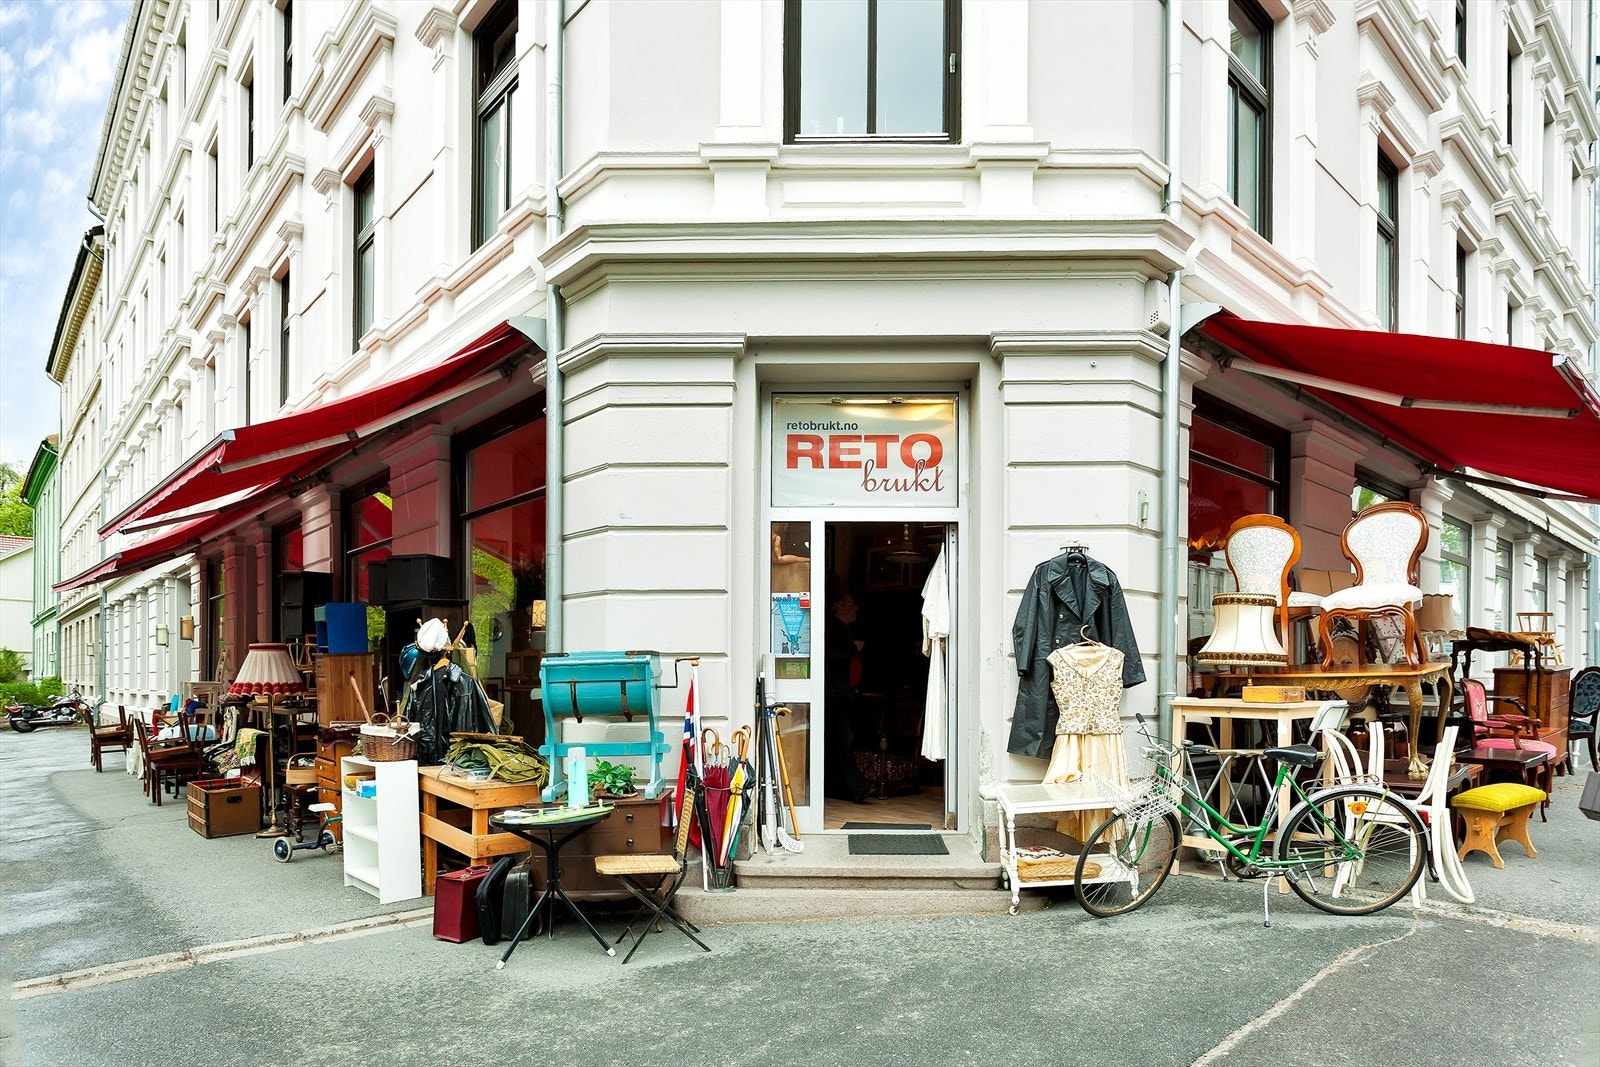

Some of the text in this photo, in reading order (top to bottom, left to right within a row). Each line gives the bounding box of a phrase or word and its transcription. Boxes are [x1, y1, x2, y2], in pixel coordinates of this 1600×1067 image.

[786, 420, 858, 431] retobrukt.no
[786, 433, 943, 469] RETO
[861, 459, 944, 492] brukt
